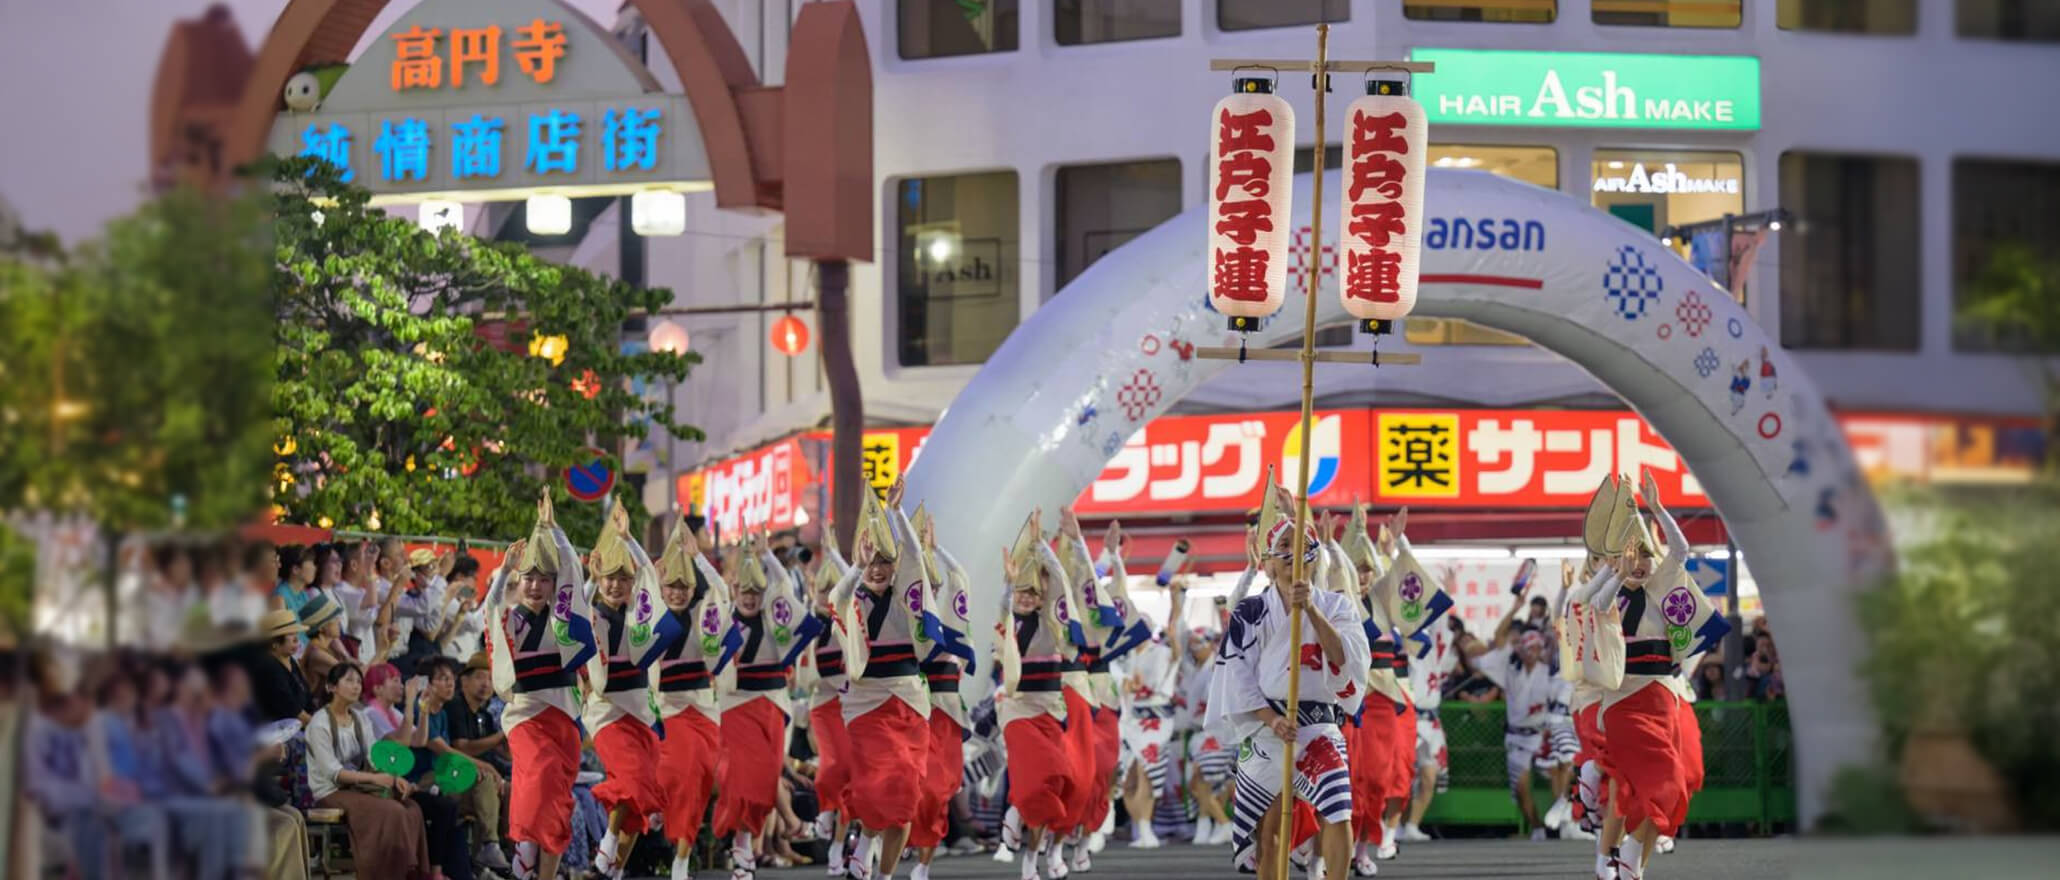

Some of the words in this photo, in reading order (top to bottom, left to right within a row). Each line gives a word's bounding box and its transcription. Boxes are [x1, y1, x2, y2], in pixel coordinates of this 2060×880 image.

[391, 19, 567, 91] 高円寺
[1439, 95, 1521, 116] HAIR
[1528, 69, 1639, 119] Ash
[1645, 100, 1734, 122] MAKE
[299, 108, 662, 183] 純情商店街
[1627, 162, 1687, 193] Ash
[1687, 178, 1738, 194] MAKE
[1214, 107, 1275, 302] 江戸っ子連
[1347, 108, 1409, 303] 江戸っ子連
[1421, 217, 1545, 251] ansan
[1388, 423, 1450, 488] 薬
